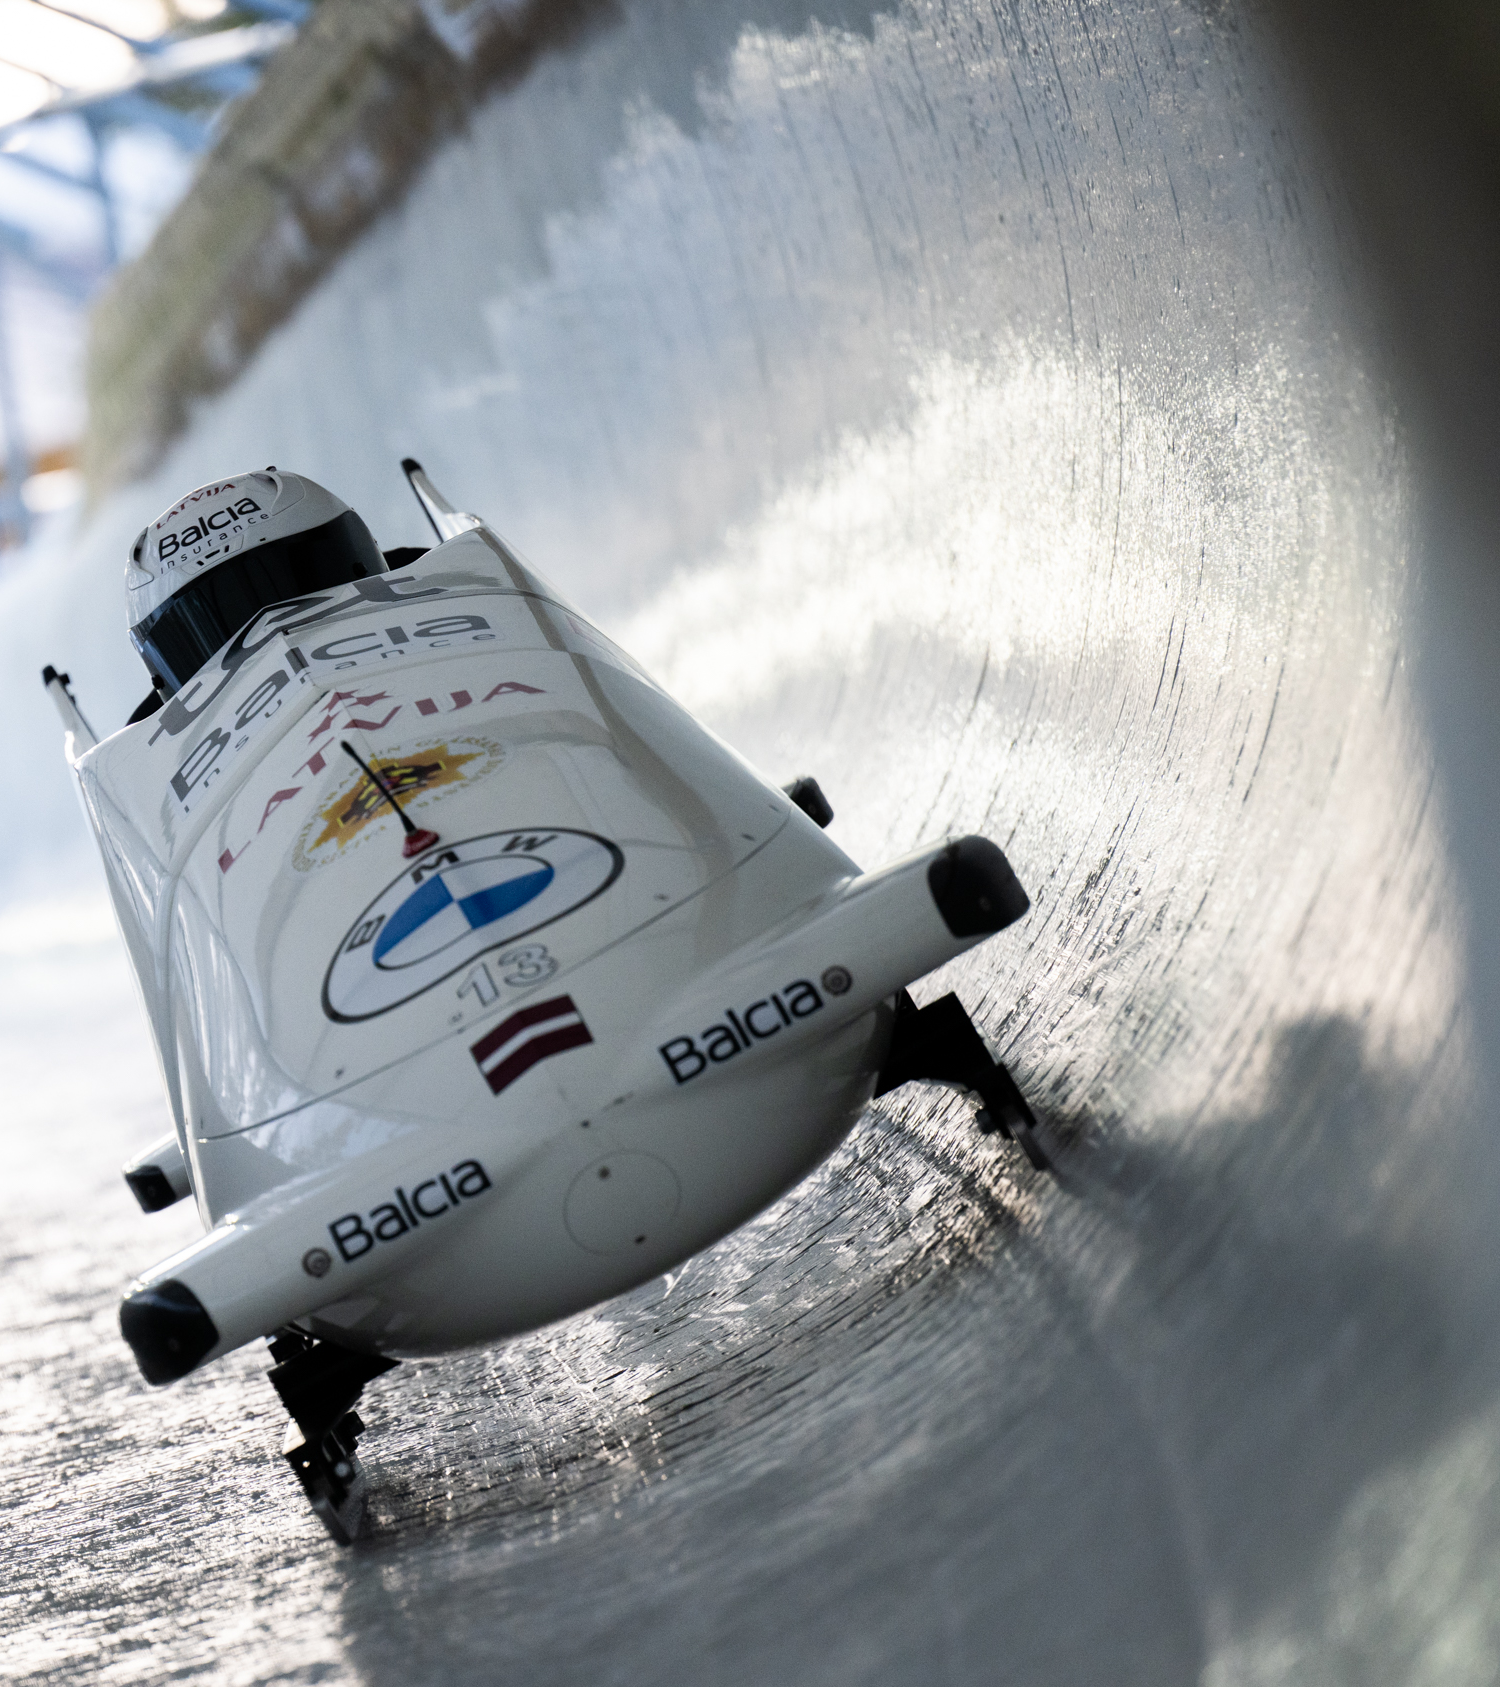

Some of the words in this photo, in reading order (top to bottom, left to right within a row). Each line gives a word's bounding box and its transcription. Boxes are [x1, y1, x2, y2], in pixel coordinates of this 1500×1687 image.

[156, 483, 236, 530] LATVIJA
[158, 497, 262, 562] Balcia
[160, 512, 269, 574] insurance
[170, 615, 491, 803] Balcia
[217, 681, 549, 874] LATVIJA
[345, 834, 558, 953] BMW
[456, 942, 559, 1008] 13
[659, 978, 824, 1086] Balcia
[327, 1159, 493, 1264] Balcia
